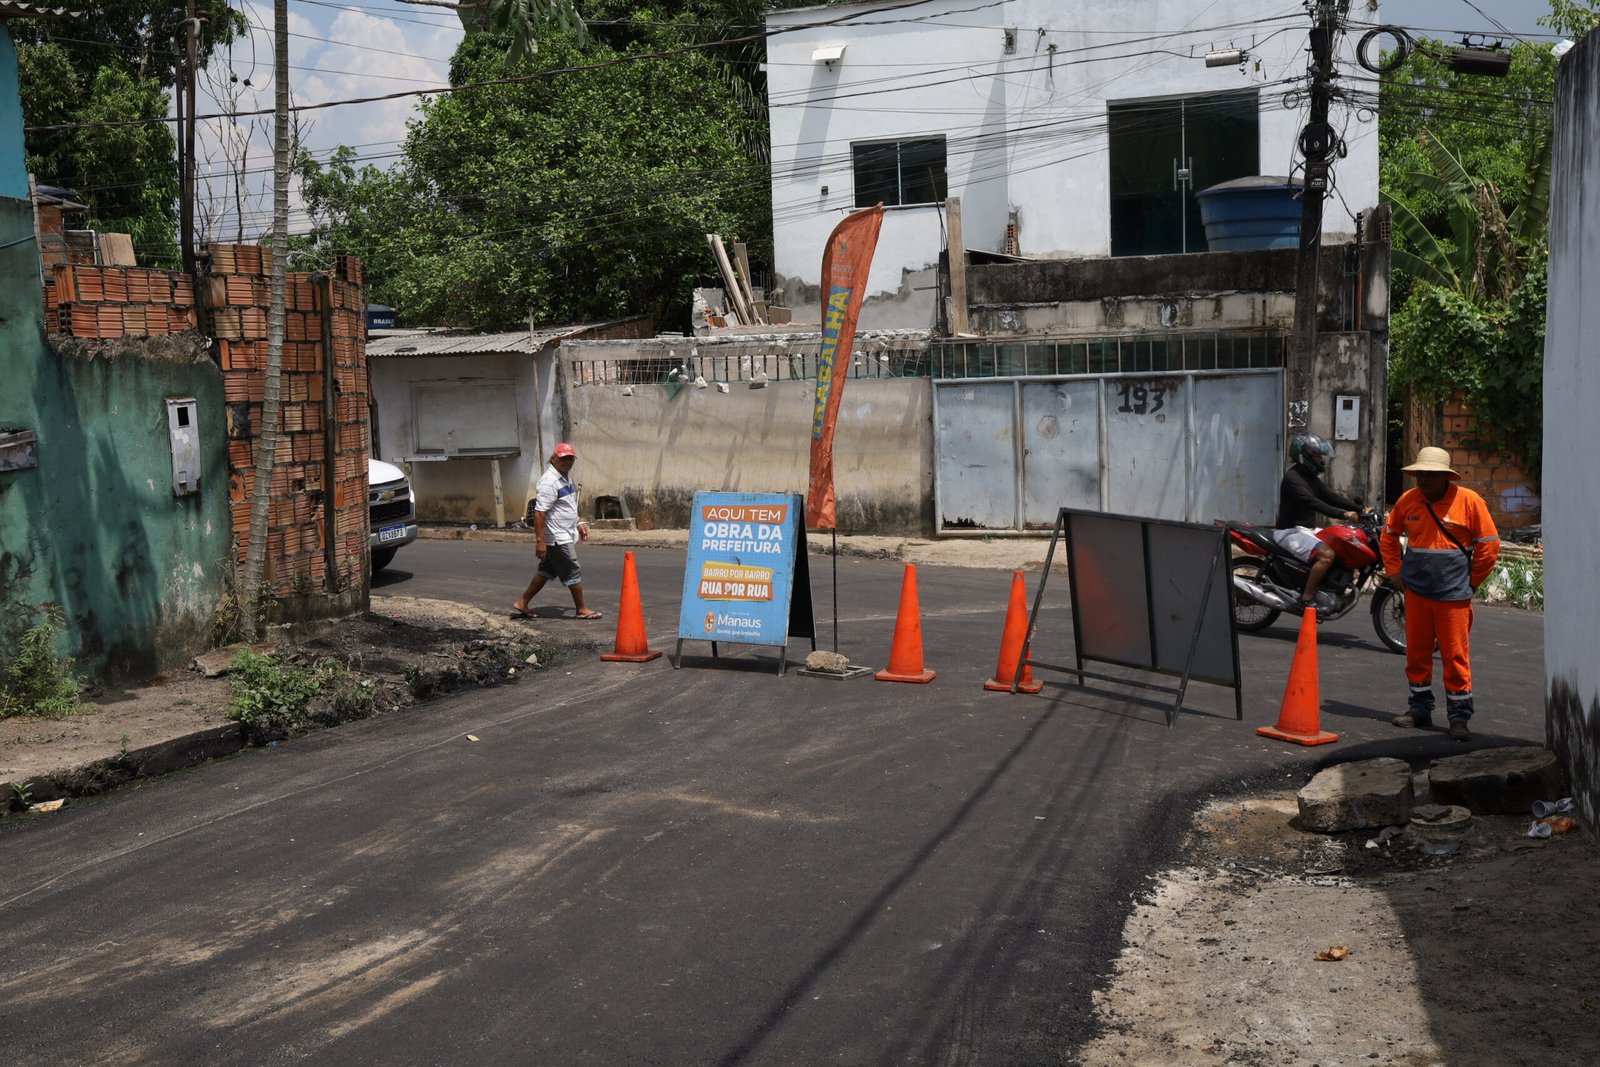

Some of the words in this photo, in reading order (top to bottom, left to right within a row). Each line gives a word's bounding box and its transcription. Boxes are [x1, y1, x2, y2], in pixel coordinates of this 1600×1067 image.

[1118, 384, 1166, 415] 193
[707, 508, 745, 521] AQUI
[749, 509, 781, 521] TEM
[704, 522, 753, 539] OBRA
[758, 524, 783, 540] DA
[702, 539, 781, 553] PREFEITURA
[704, 567, 729, 578] BAIRRO
[729, 569, 744, 579] POR
[744, 570, 770, 580] BAIRRO
[701, 581, 722, 595] RUA
[724, 582, 745, 596] POR
[746, 584, 768, 597] RUA
[717, 614, 761, 629] Manaus
